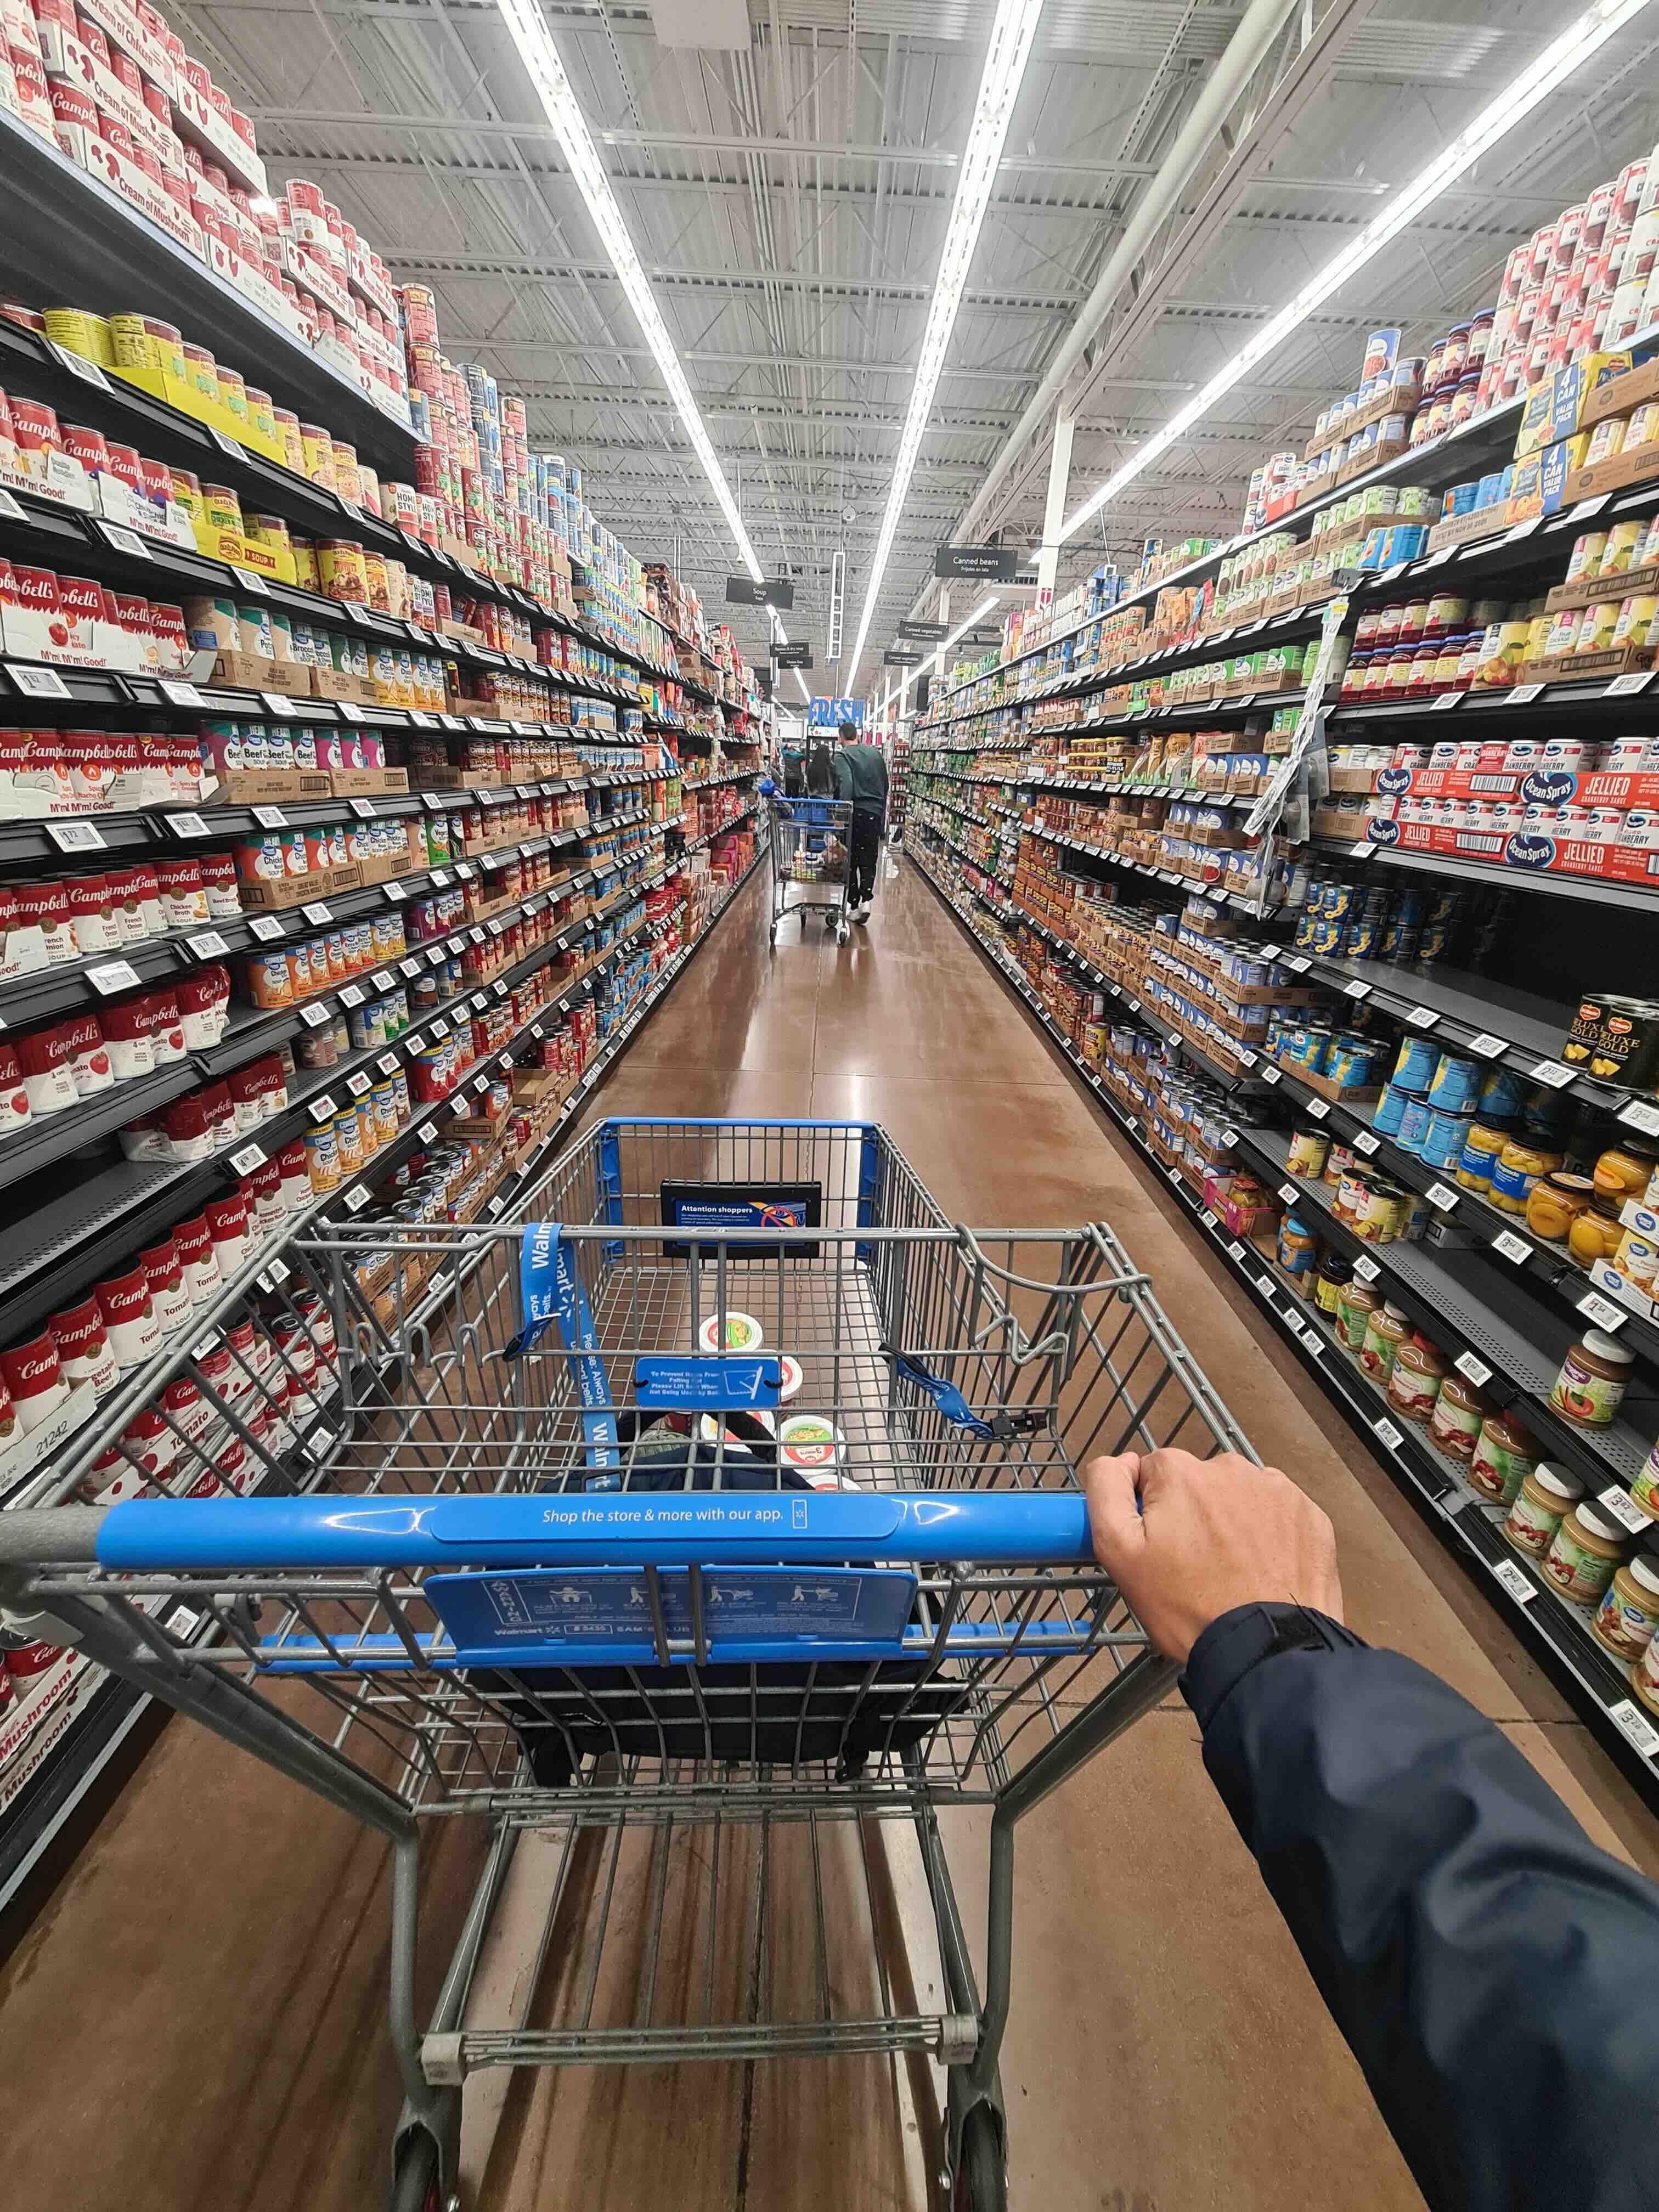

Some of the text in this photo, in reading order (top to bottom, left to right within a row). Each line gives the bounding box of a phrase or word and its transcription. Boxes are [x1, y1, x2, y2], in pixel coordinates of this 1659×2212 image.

[119, 177, 145, 206] Cream
[153, 206, 190, 243] Mushroom
[1561, 366, 1572, 385] 4
[1556, 384, 1576, 403] CAN
[1547, 443, 1561, 466] 4
[1544, 462, 1564, 480] CAN
[251, 553, 269, 567] SOUP
[953, 557, 998, 566] Canned beans
[16, 579, 53, 599] bell's
[752, 588, 767, 597] Soup
[808, 697, 864, 727] FRESH
[244, 748, 263, 758] Beef
[1379, 772, 1409, 791] Ocean Spray
[1417, 771, 1445, 787] JELLIED
[1584, 776, 1631, 797] JELLIED
[1525, 777, 1572, 802] Ocean Spray
[1369, 823, 1397, 842] Ocean Spray
[1404, 825, 1431, 841] JELLIED
[1509, 839, 1551, 862] Ocean Spray
[1564, 843, 1605, 865] JELLIED
[1571, 1026, 1599, 1040] GOLD
[1599, 1031, 1641, 1048] ELUXE
[1598, 1039, 1629, 1054] GOLD
[681, 1205, 753, 1215] Attention shoppers
[531, 1223, 554, 1270] Walm
[94, 1372, 112, 1387] Beef
[94, 1380, 115, 1396] SOUP
[591, 1370, 606, 1406] Always
[36, 1420, 68, 1455] 21242
[543, 1508, 784, 1525] Shop the store & more with our app.
[494, 1626, 543, 1637] Walmart
[0, 1668, 71, 1757] Mushroom
[4, 1711, 72, 1802] Mushroom
